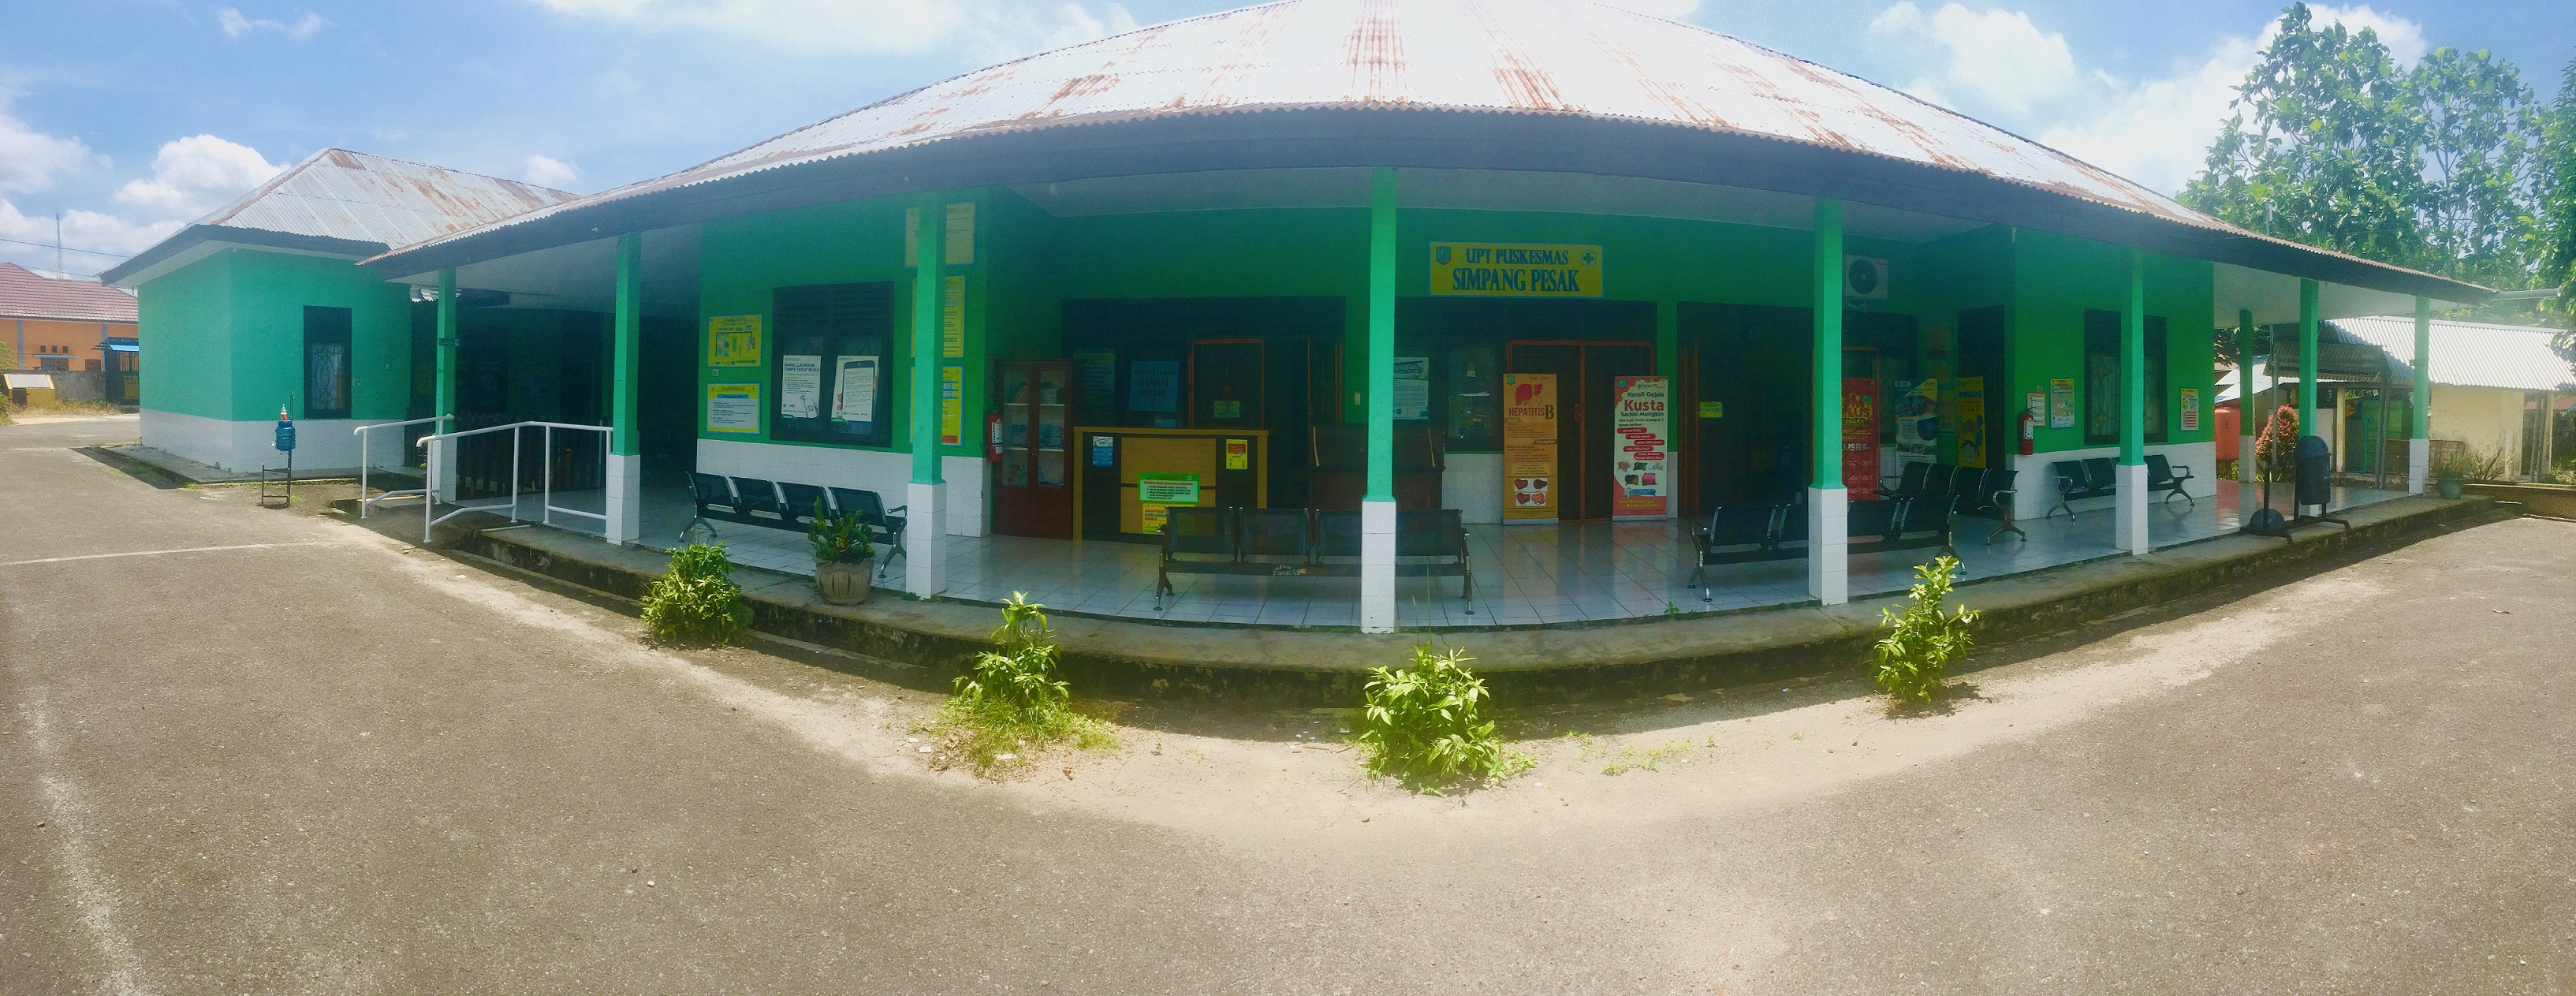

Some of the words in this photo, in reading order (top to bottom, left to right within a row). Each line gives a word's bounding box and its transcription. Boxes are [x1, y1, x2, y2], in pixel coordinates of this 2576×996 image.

[1465, 248, 1491, 264] UPT
[1496, 249, 1568, 266] PUSKESMAS
[1452, 267, 1526, 292] SIMPANG
[1530, 269, 1580, 292] PESAK
[1139, 379, 1169, 387] REKAM
[1508, 407, 1545, 416] HEPATITIS
[1545, 405, 1555, 420] B
[1624, 399, 1665, 412] Kusta
